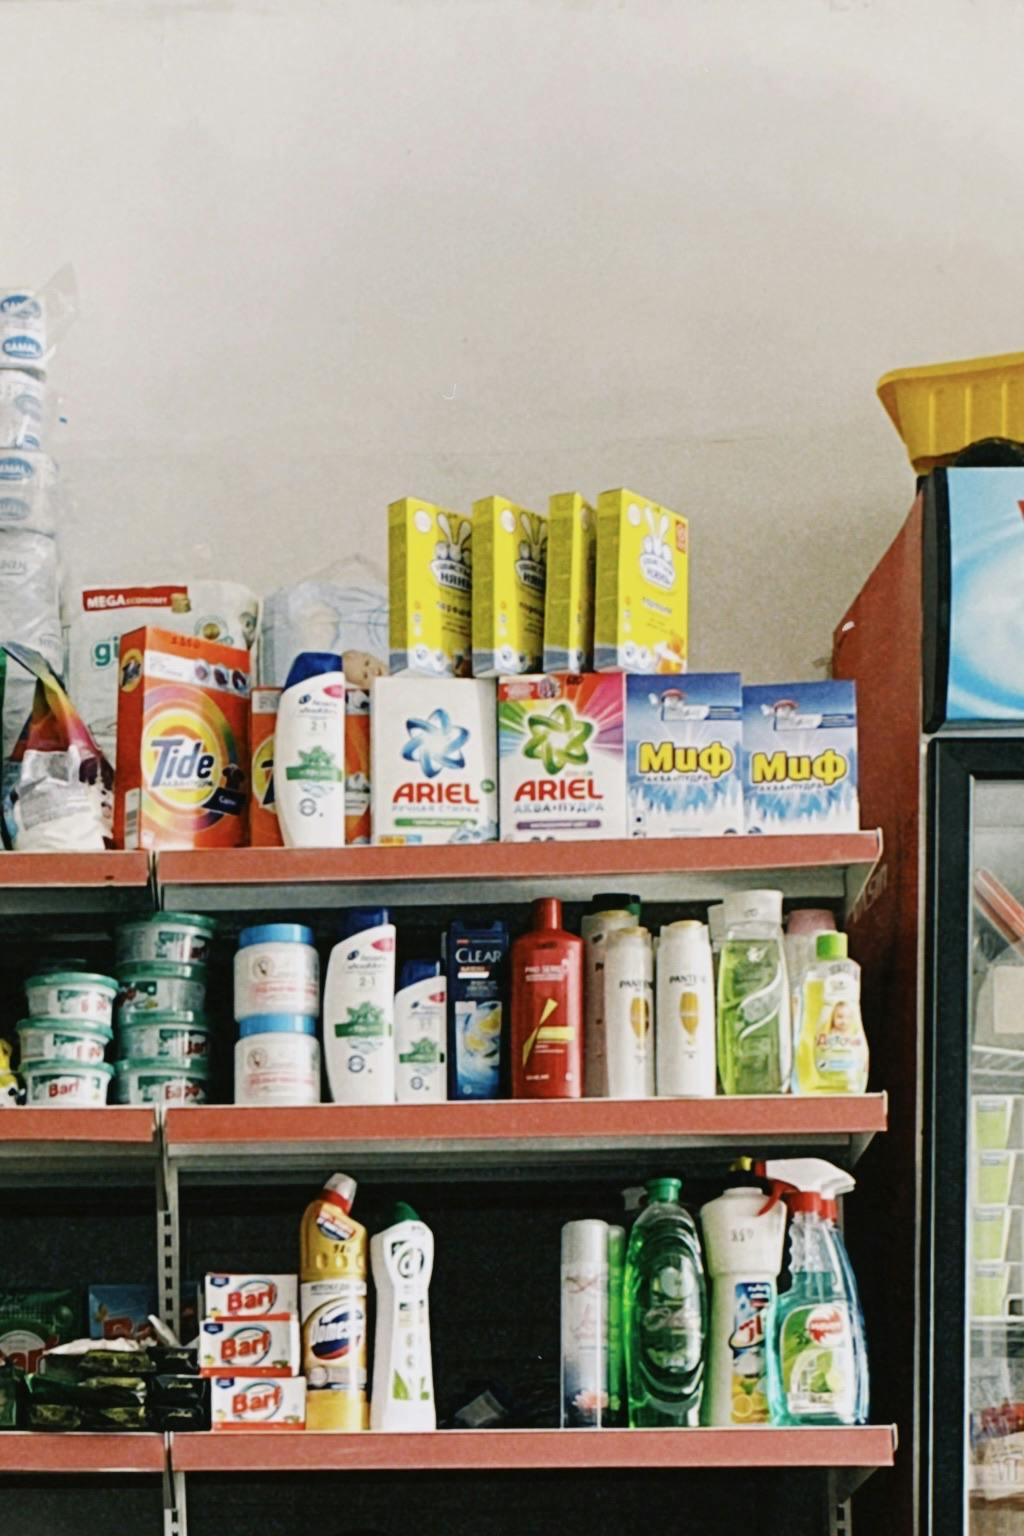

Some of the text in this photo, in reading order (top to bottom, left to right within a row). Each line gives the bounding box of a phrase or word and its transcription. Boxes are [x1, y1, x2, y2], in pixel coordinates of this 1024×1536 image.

[4, 341, 38, 351] SAMAL
[87, 594, 126, 609] MEGA
[150, 739, 215, 788] Tide
[639, 740, 734, 778] Миф
[751, 748, 848, 786] Миф
[392, 782, 480, 804] ARIEL
[513, 778, 604, 802] ARIEL
[455, 947, 502, 964] CLEAR
[227, 1283, 276, 1313] Barf
[221, 1330, 270, 1361] Barf
[232, 1385, 282, 1415] Barf
